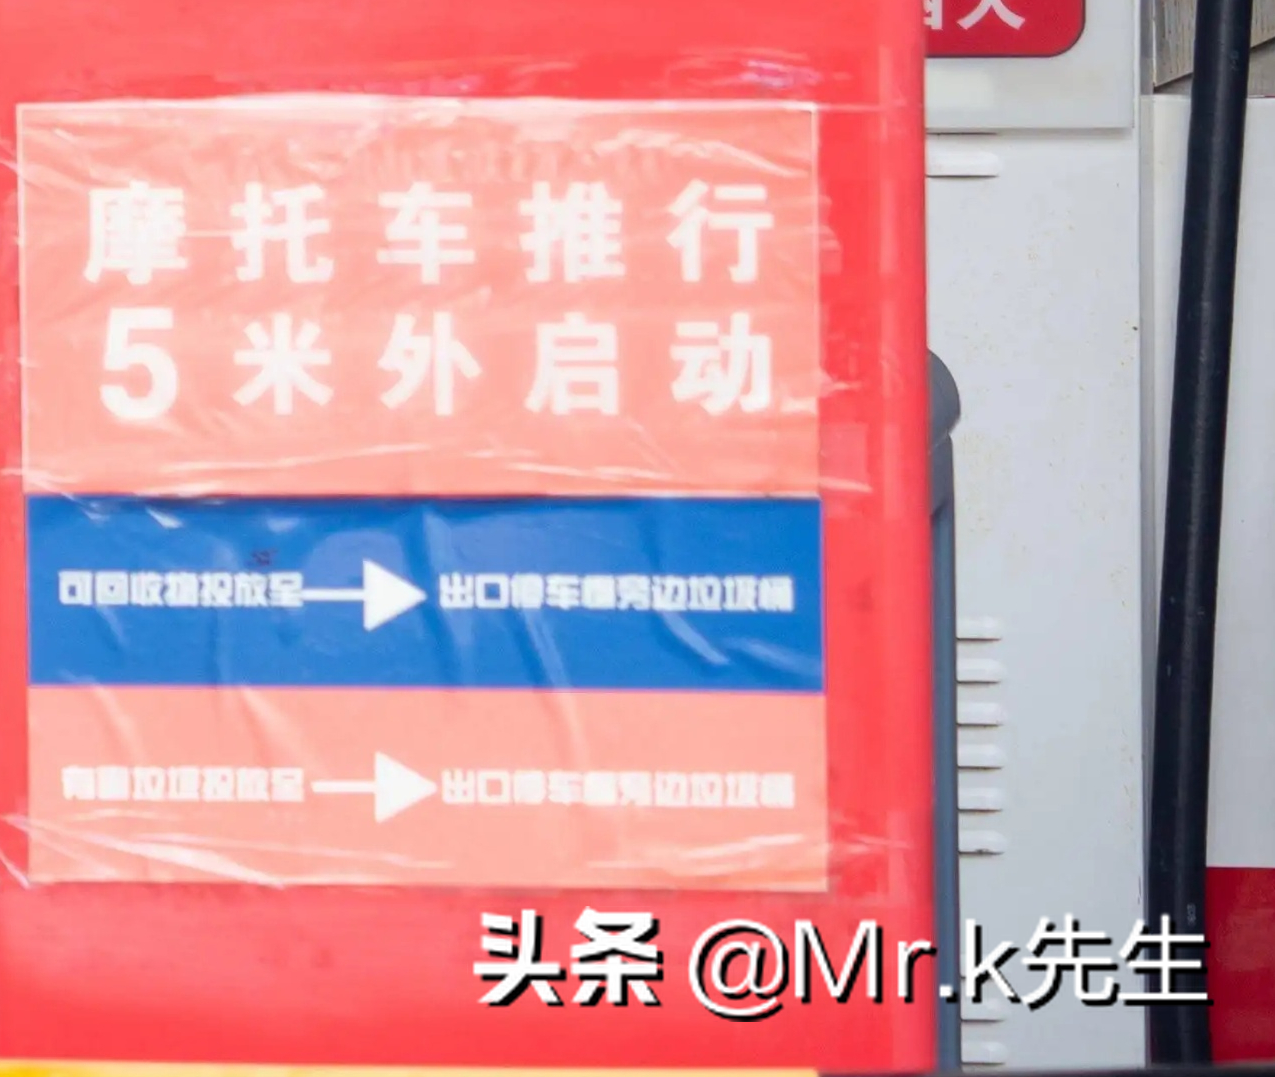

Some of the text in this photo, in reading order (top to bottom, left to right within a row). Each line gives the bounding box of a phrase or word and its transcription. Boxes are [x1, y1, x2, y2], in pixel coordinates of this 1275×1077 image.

[83, 179, 775, 286] 摩托车推行
[97, 305, 774, 421] 5米外启动
